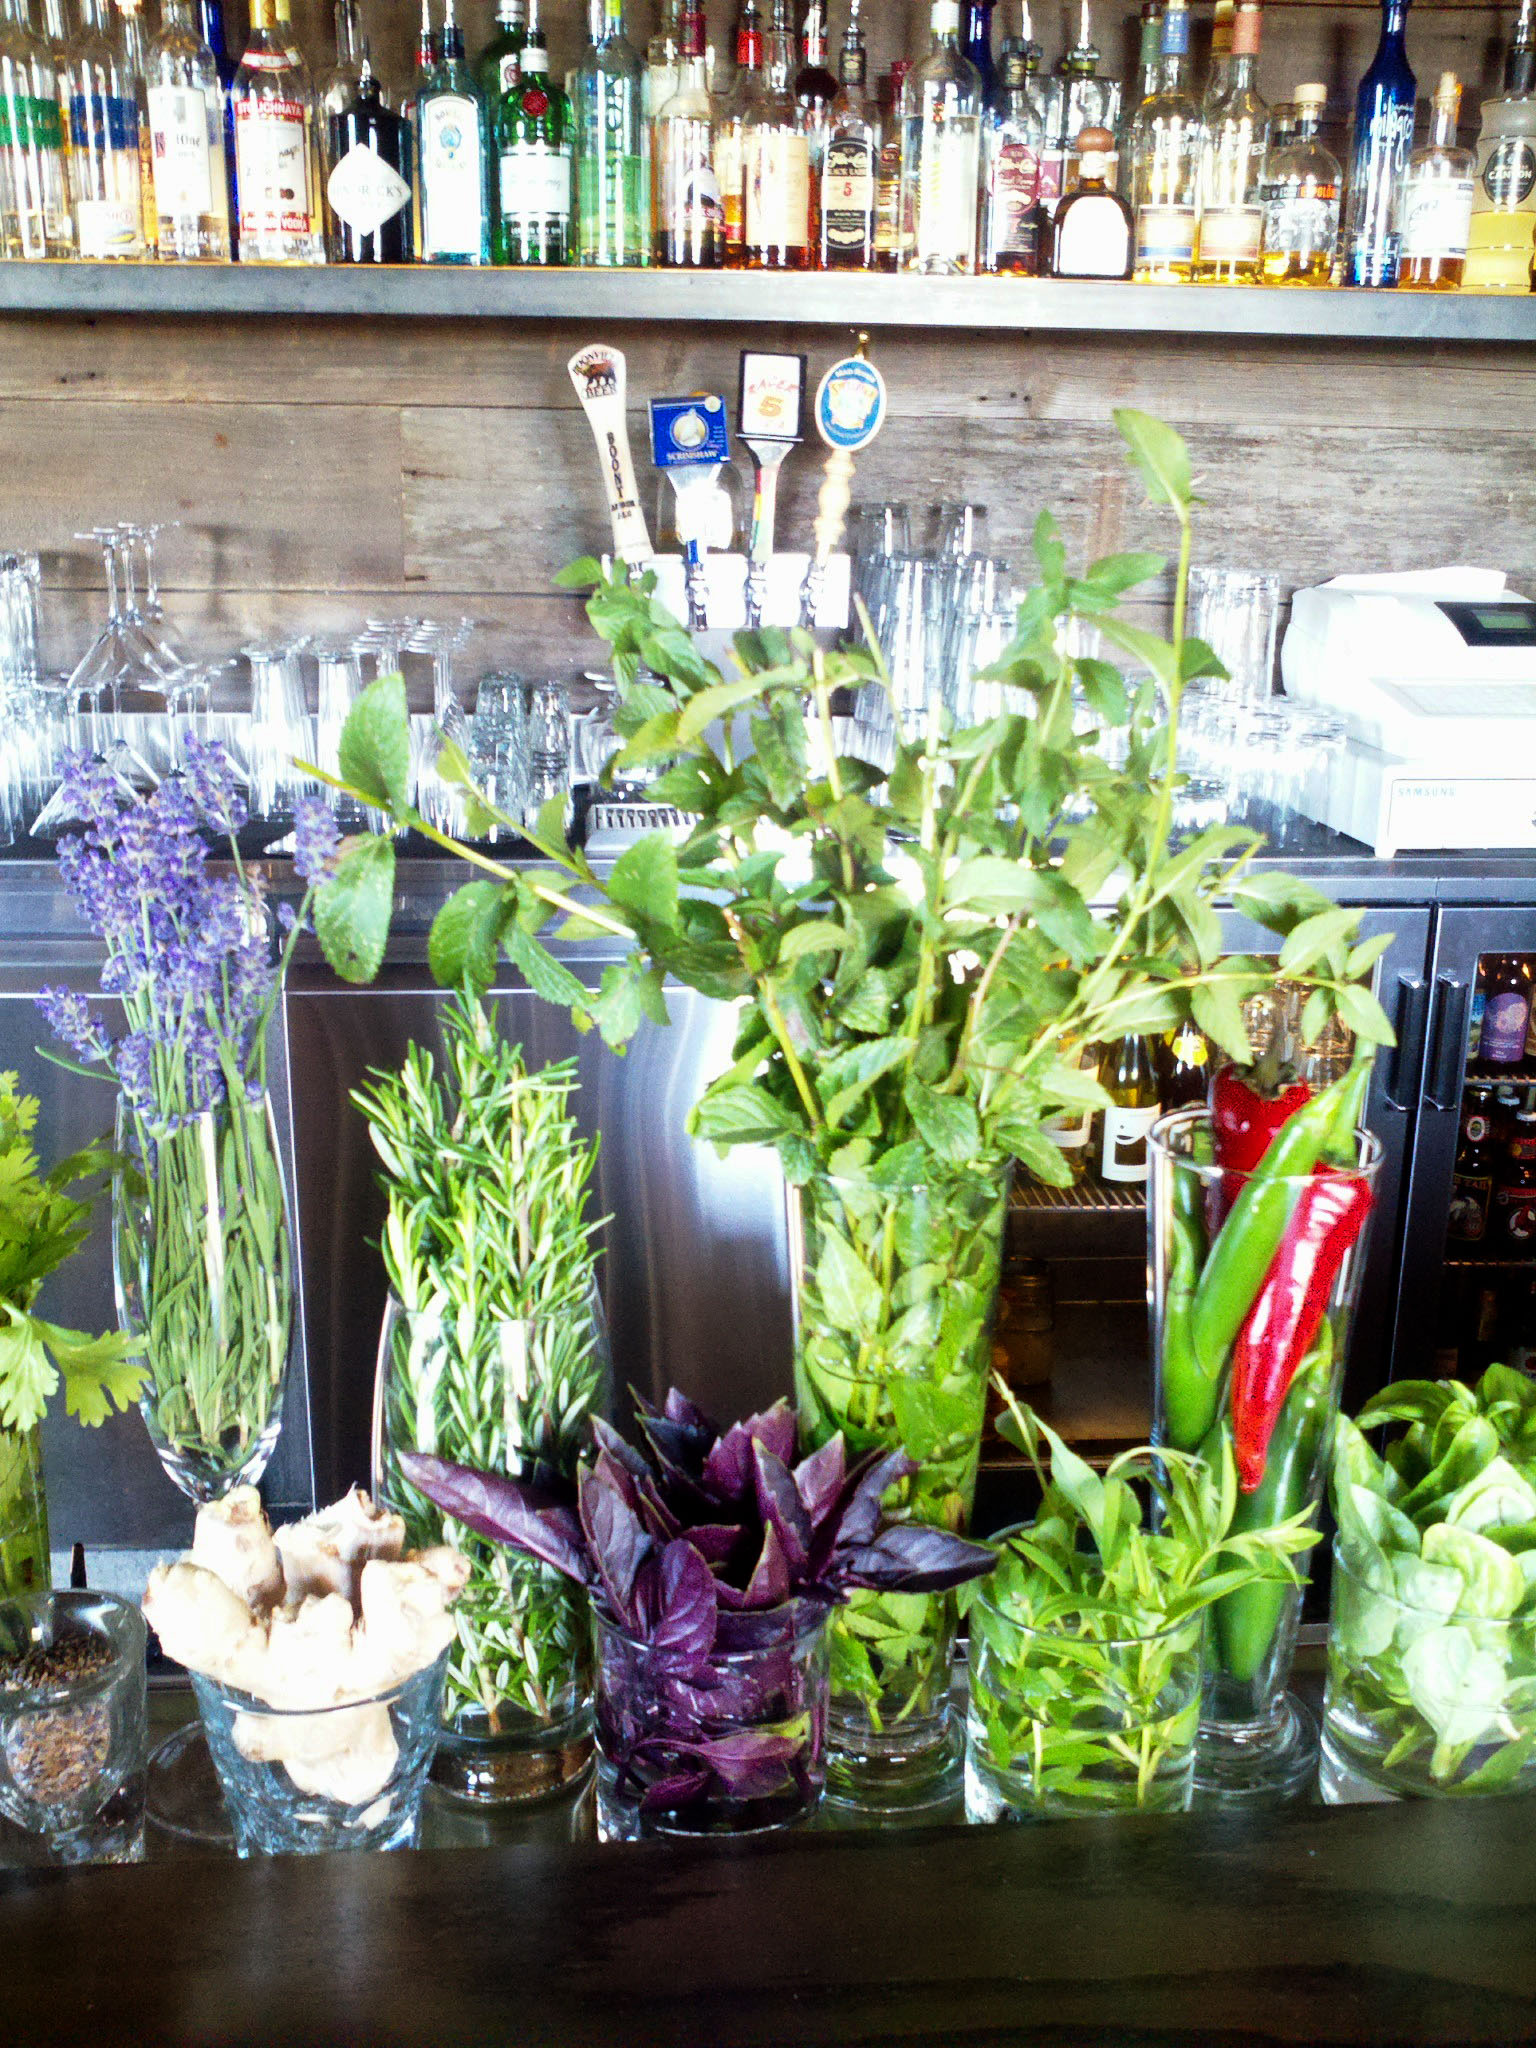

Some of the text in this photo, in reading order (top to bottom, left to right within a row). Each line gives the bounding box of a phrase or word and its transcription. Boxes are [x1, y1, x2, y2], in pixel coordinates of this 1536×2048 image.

[842, 182, 852, 197] 5
[585, 386, 616, 399] BEER
[757, 395, 784, 417] 5
[1398, 787, 1456, 797] SAMSUNG
